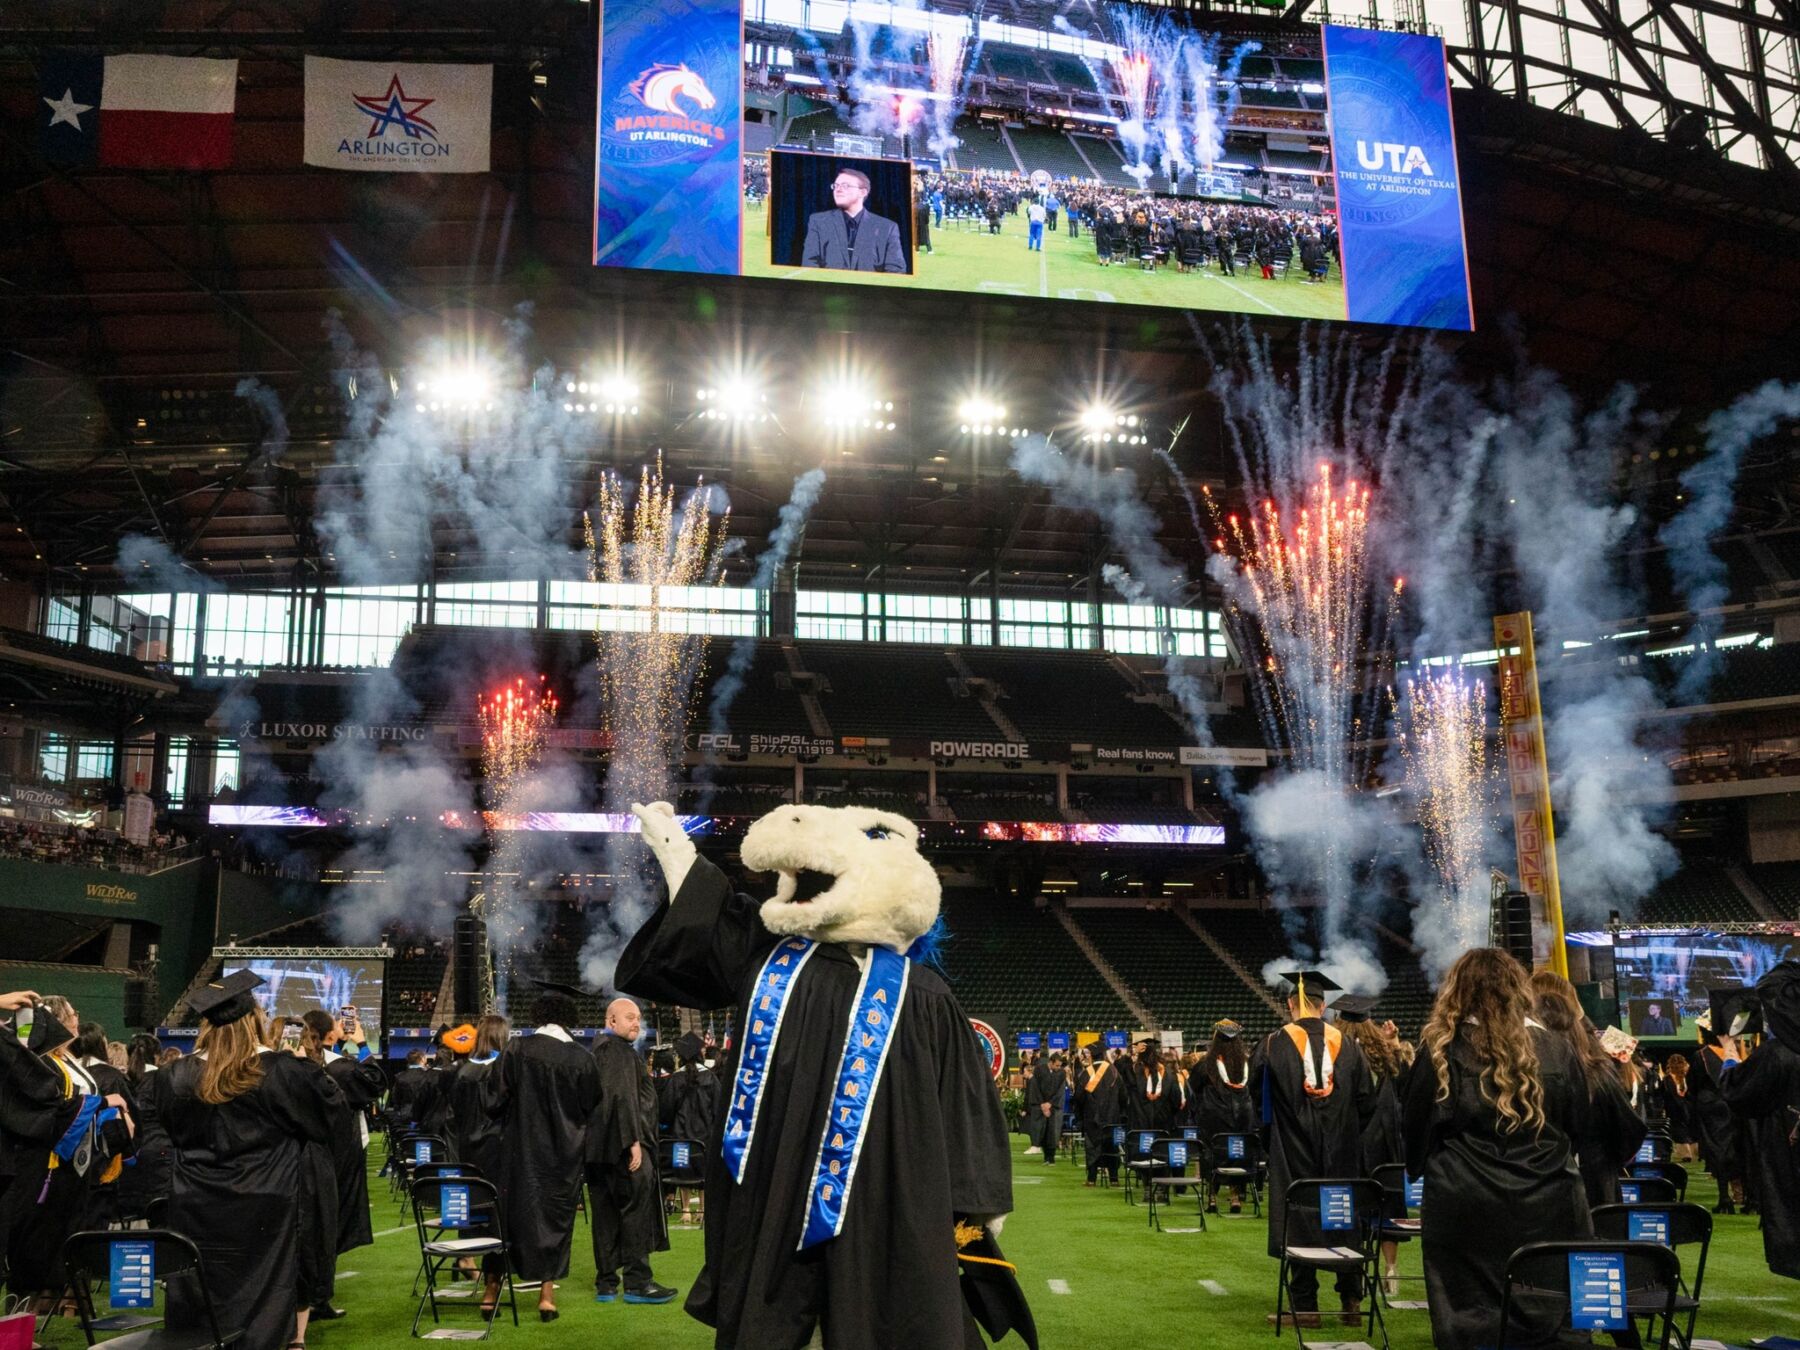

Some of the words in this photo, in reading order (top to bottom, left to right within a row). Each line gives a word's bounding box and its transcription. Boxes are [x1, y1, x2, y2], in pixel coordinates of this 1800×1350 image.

[615, 115, 725, 141] MAVERICKS
[630, 131, 644, 141] UT
[645, 130, 709, 147] ARLINGTON
[337, 139, 449, 157] ARLINGTON
[1356, 140, 1434, 176] UTA
[1340, 171, 1358, 180] THE
[1360, 173, 1412, 185] UNIVERSITY
[1413, 178, 1426, 186] OF
[1427, 179, 1456, 189] TEXAS
[1366, 183, 1378, 191] AT
[1380, 185, 1432, 195] ARLINGTON
[261, 722, 328, 738] LUXOR
[333, 723, 425, 741] STAFFING
[698, 734, 741, 748] PGL
[750, 734, 834, 747] ShipPGL.com
[750, 744, 835, 755] 877.701.1919
[930, 741, 1030, 758] POWERADE
[1097, 748, 1120, 758] Real
[1122, 749, 1144, 759] fans
[1145, 749, 1175, 760] know.
[821, 988, 888, 1201] ADVANTAGE
